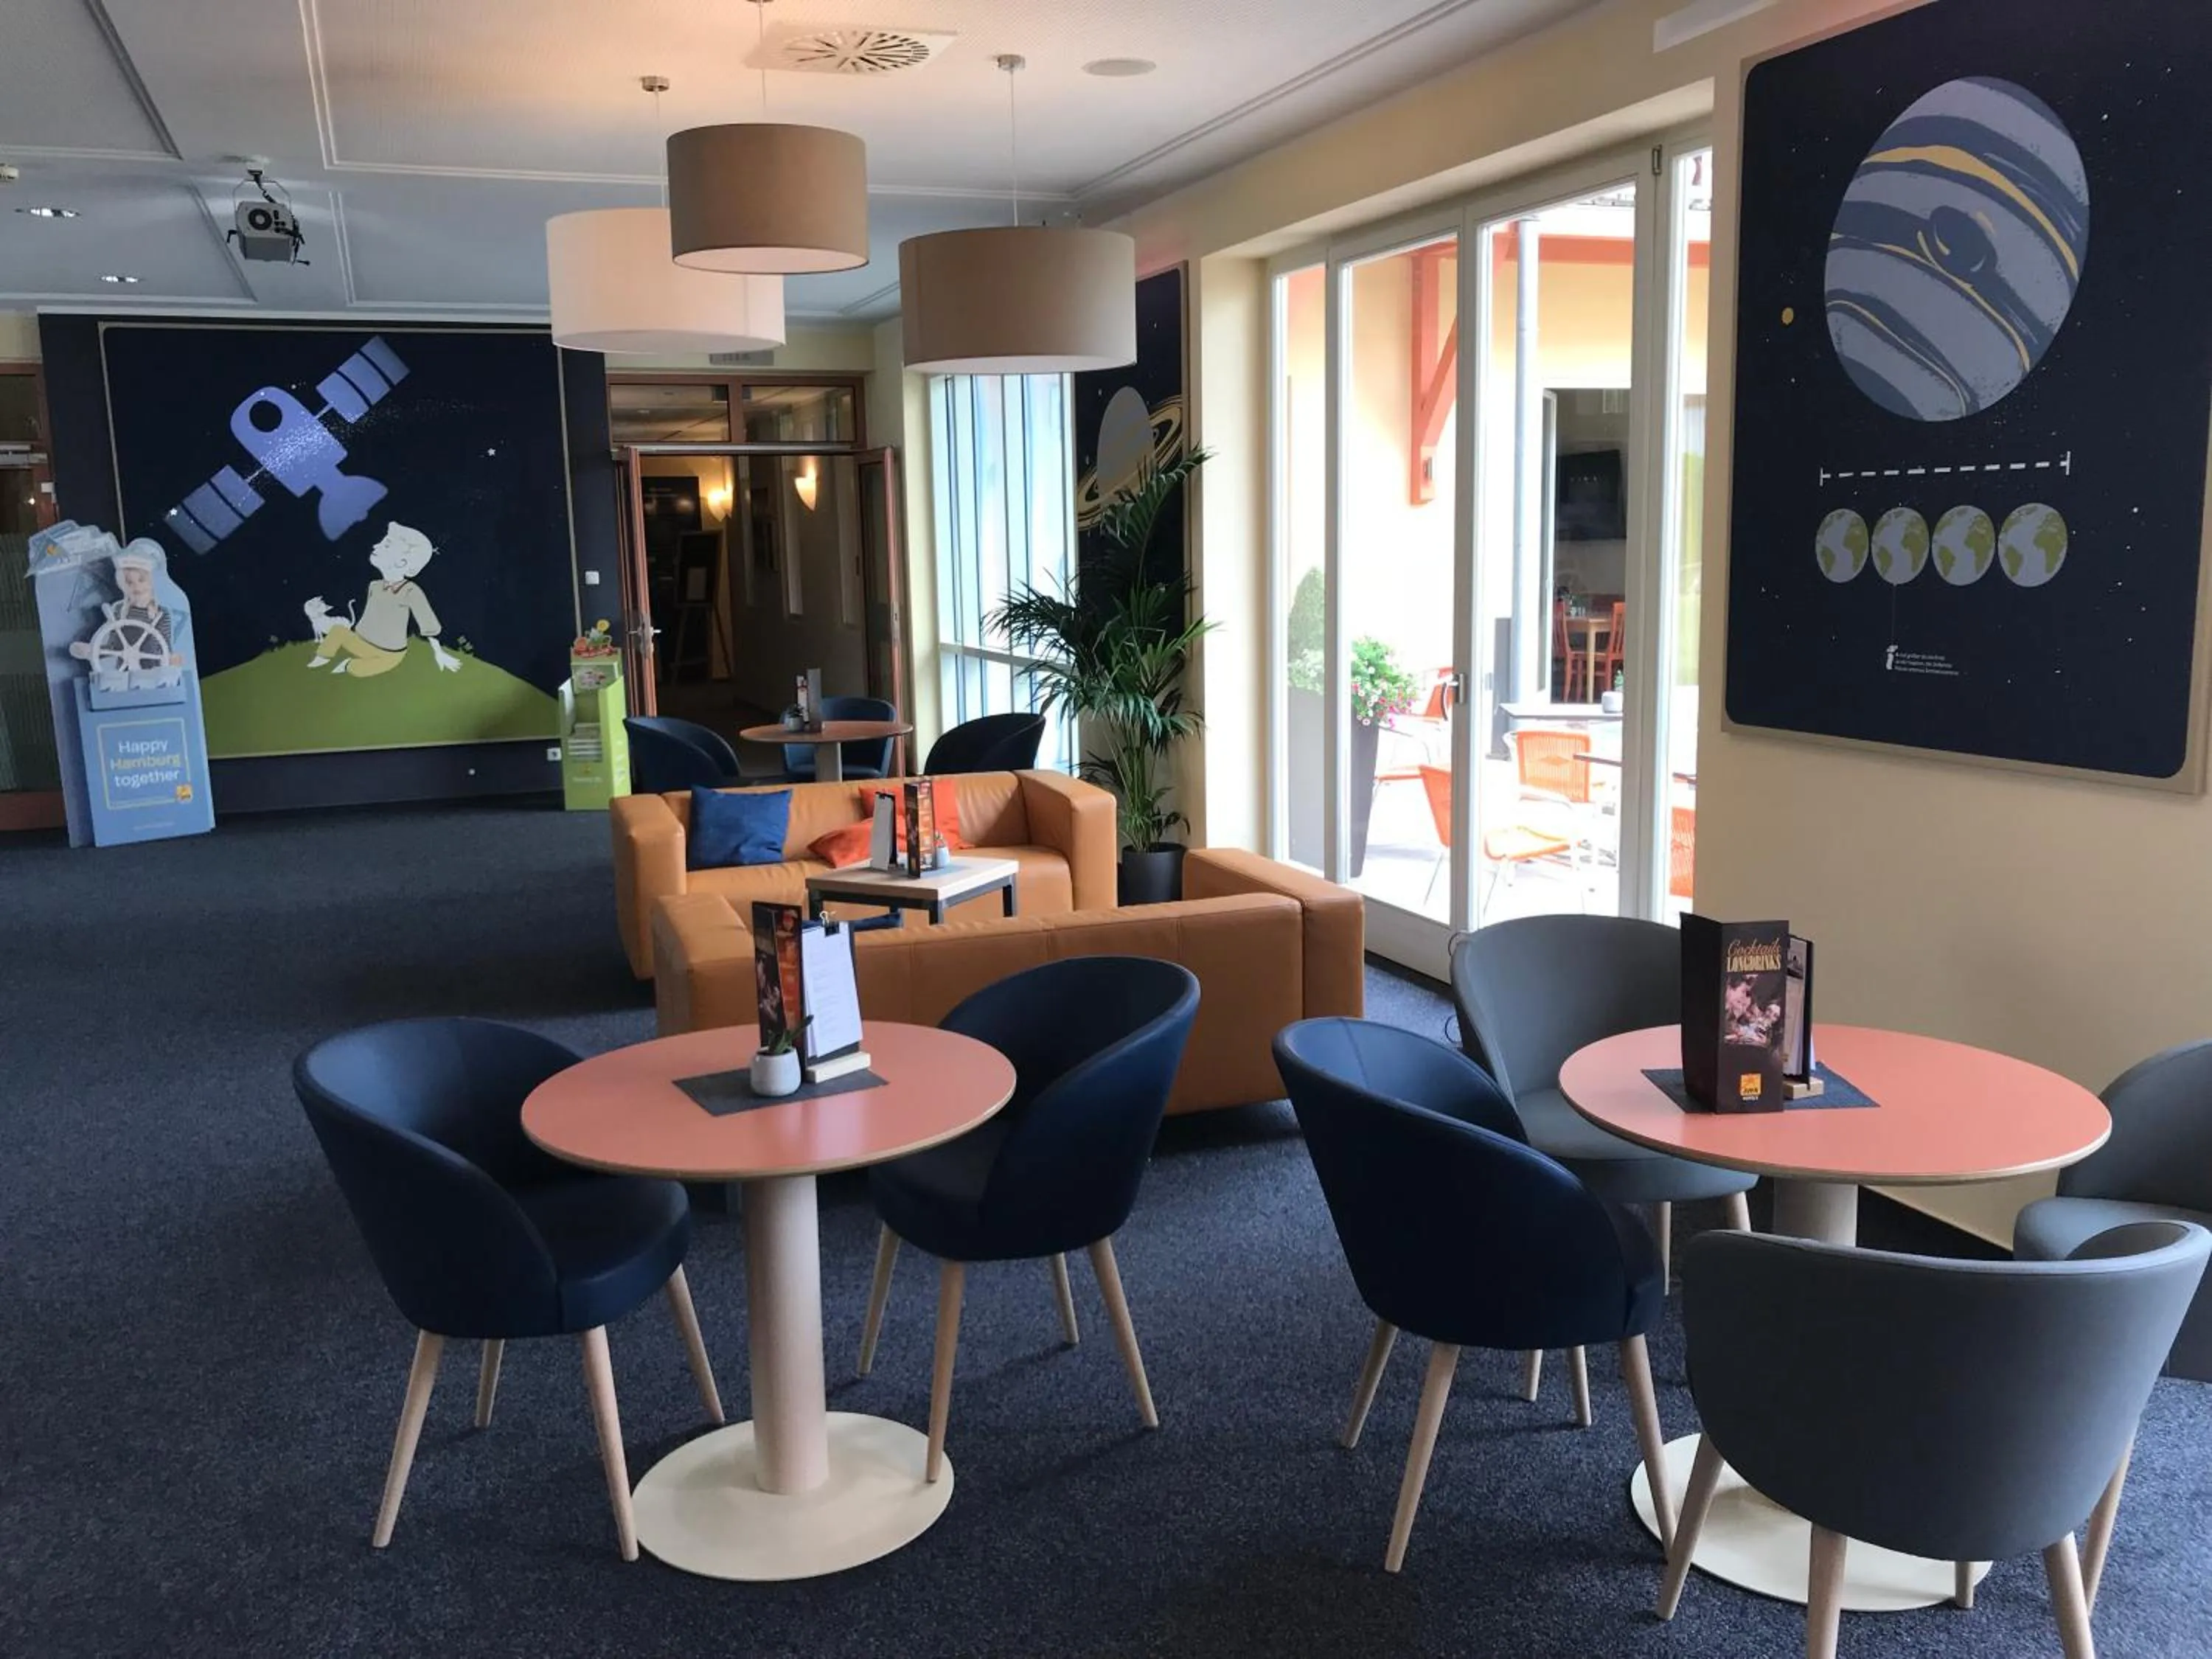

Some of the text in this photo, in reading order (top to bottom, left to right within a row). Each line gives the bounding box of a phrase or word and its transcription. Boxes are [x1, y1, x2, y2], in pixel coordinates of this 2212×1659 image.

[118, 740, 168, 755] Happy
[110, 754, 181, 770] Hamburg
[114, 770, 180, 788] together
[1727, 937, 1781, 957] Cocktails
